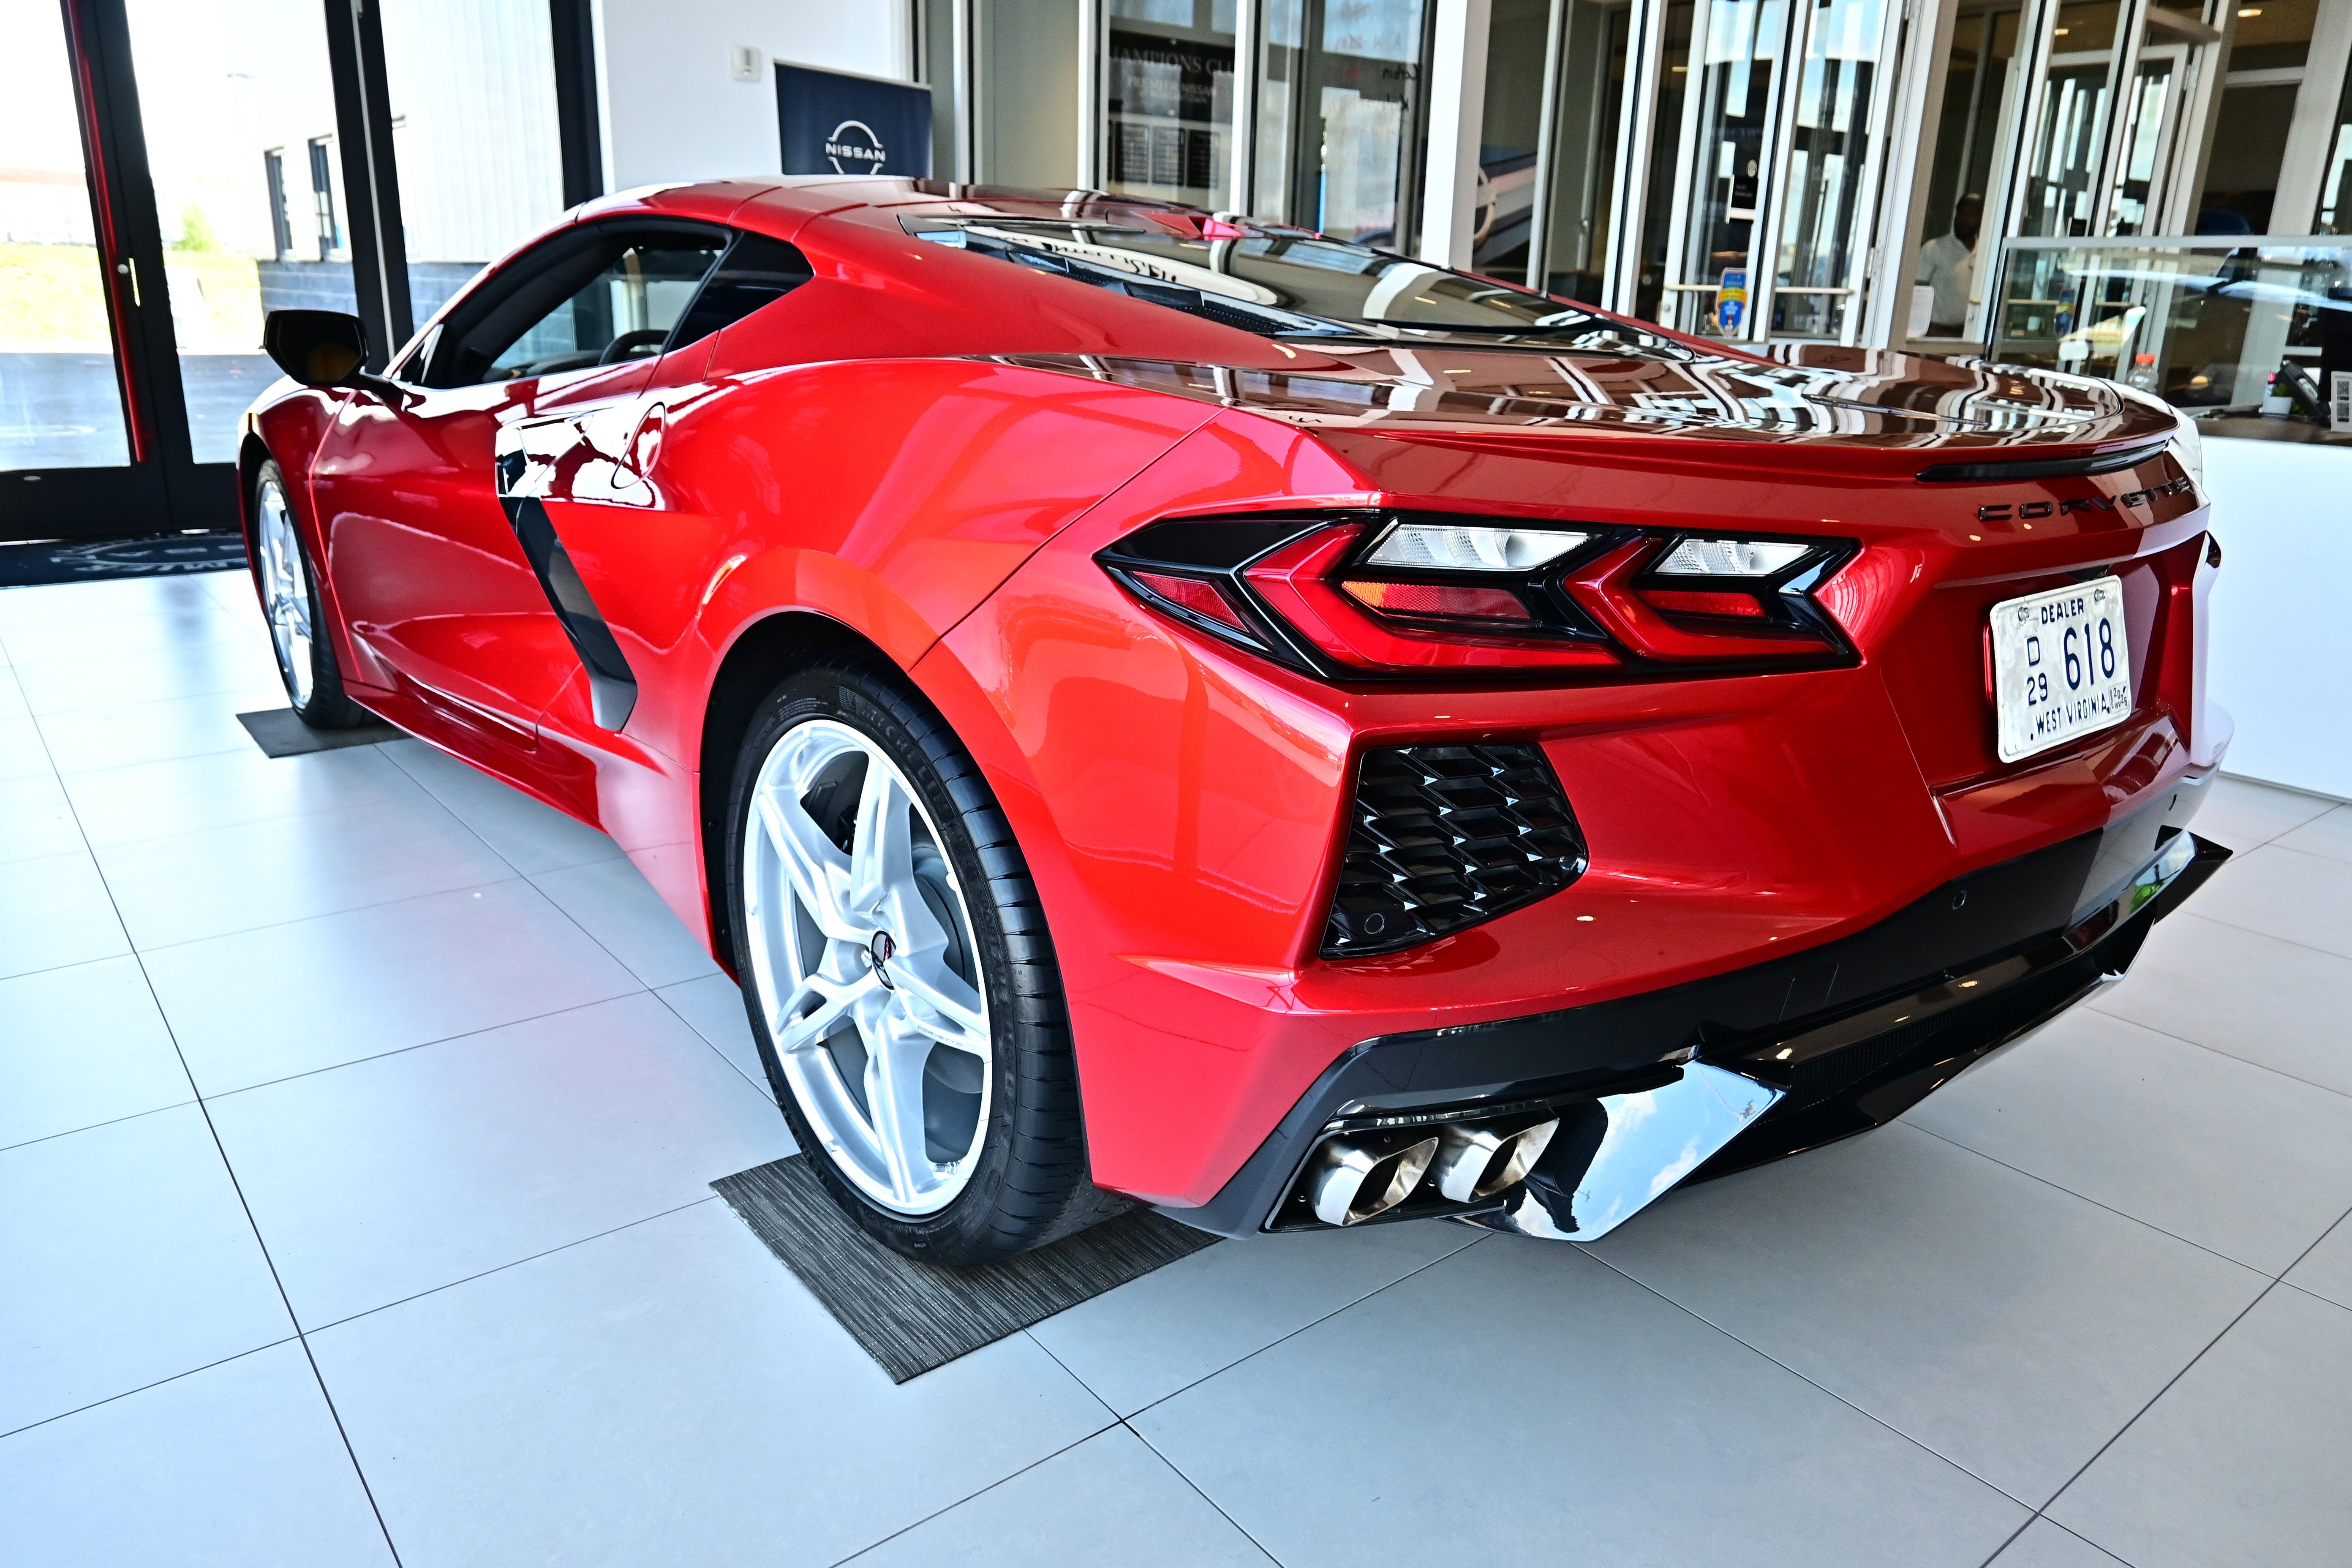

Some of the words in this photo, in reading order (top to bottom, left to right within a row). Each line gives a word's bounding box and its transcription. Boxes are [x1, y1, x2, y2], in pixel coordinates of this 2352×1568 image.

[825, 142, 886, 162] NISSAN
[1978, 476, 2190, 521] CORVETTE
[2041, 598, 2084, 624] DEALER
[2027, 636, 2040, 667] D
[2064, 618, 2115, 690] 618
[2027, 672, 2048, 706] 29
[2036, 708, 2061, 736] WEST
[2066, 693, 2107, 725] VIRGINIA
[2114, 701, 2121, 709] WV
[917, 1026, 962, 1047] CORVETTE
